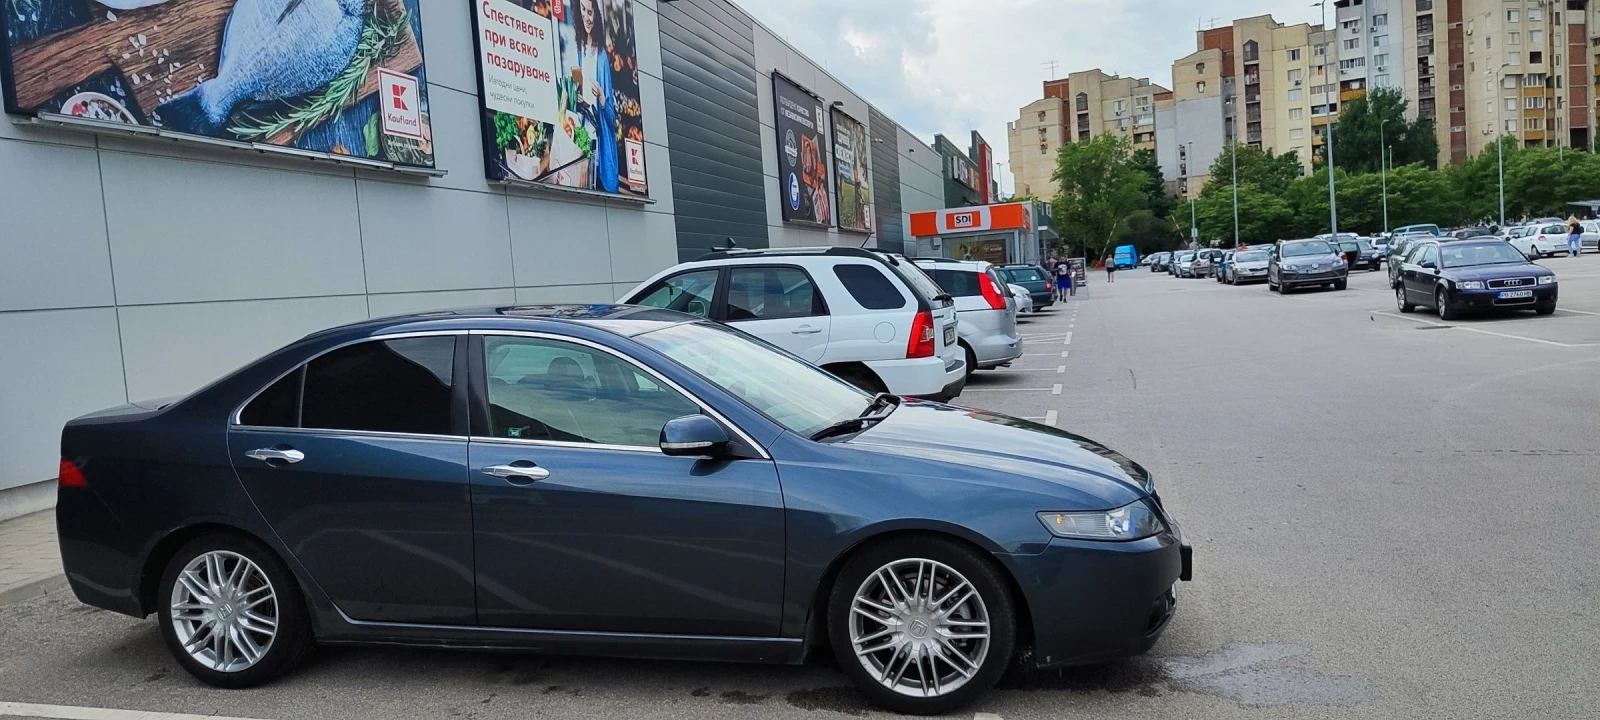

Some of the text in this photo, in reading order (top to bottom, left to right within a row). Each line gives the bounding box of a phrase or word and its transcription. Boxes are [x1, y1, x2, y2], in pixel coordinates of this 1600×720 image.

[483, 1, 545, 40] Спестявате
[485, 29, 538, 58] при всяко
[487, 52, 550, 83] пазаруване
[388, 113, 417, 127] Kaufland
[955, 215, 971, 224] SDI
